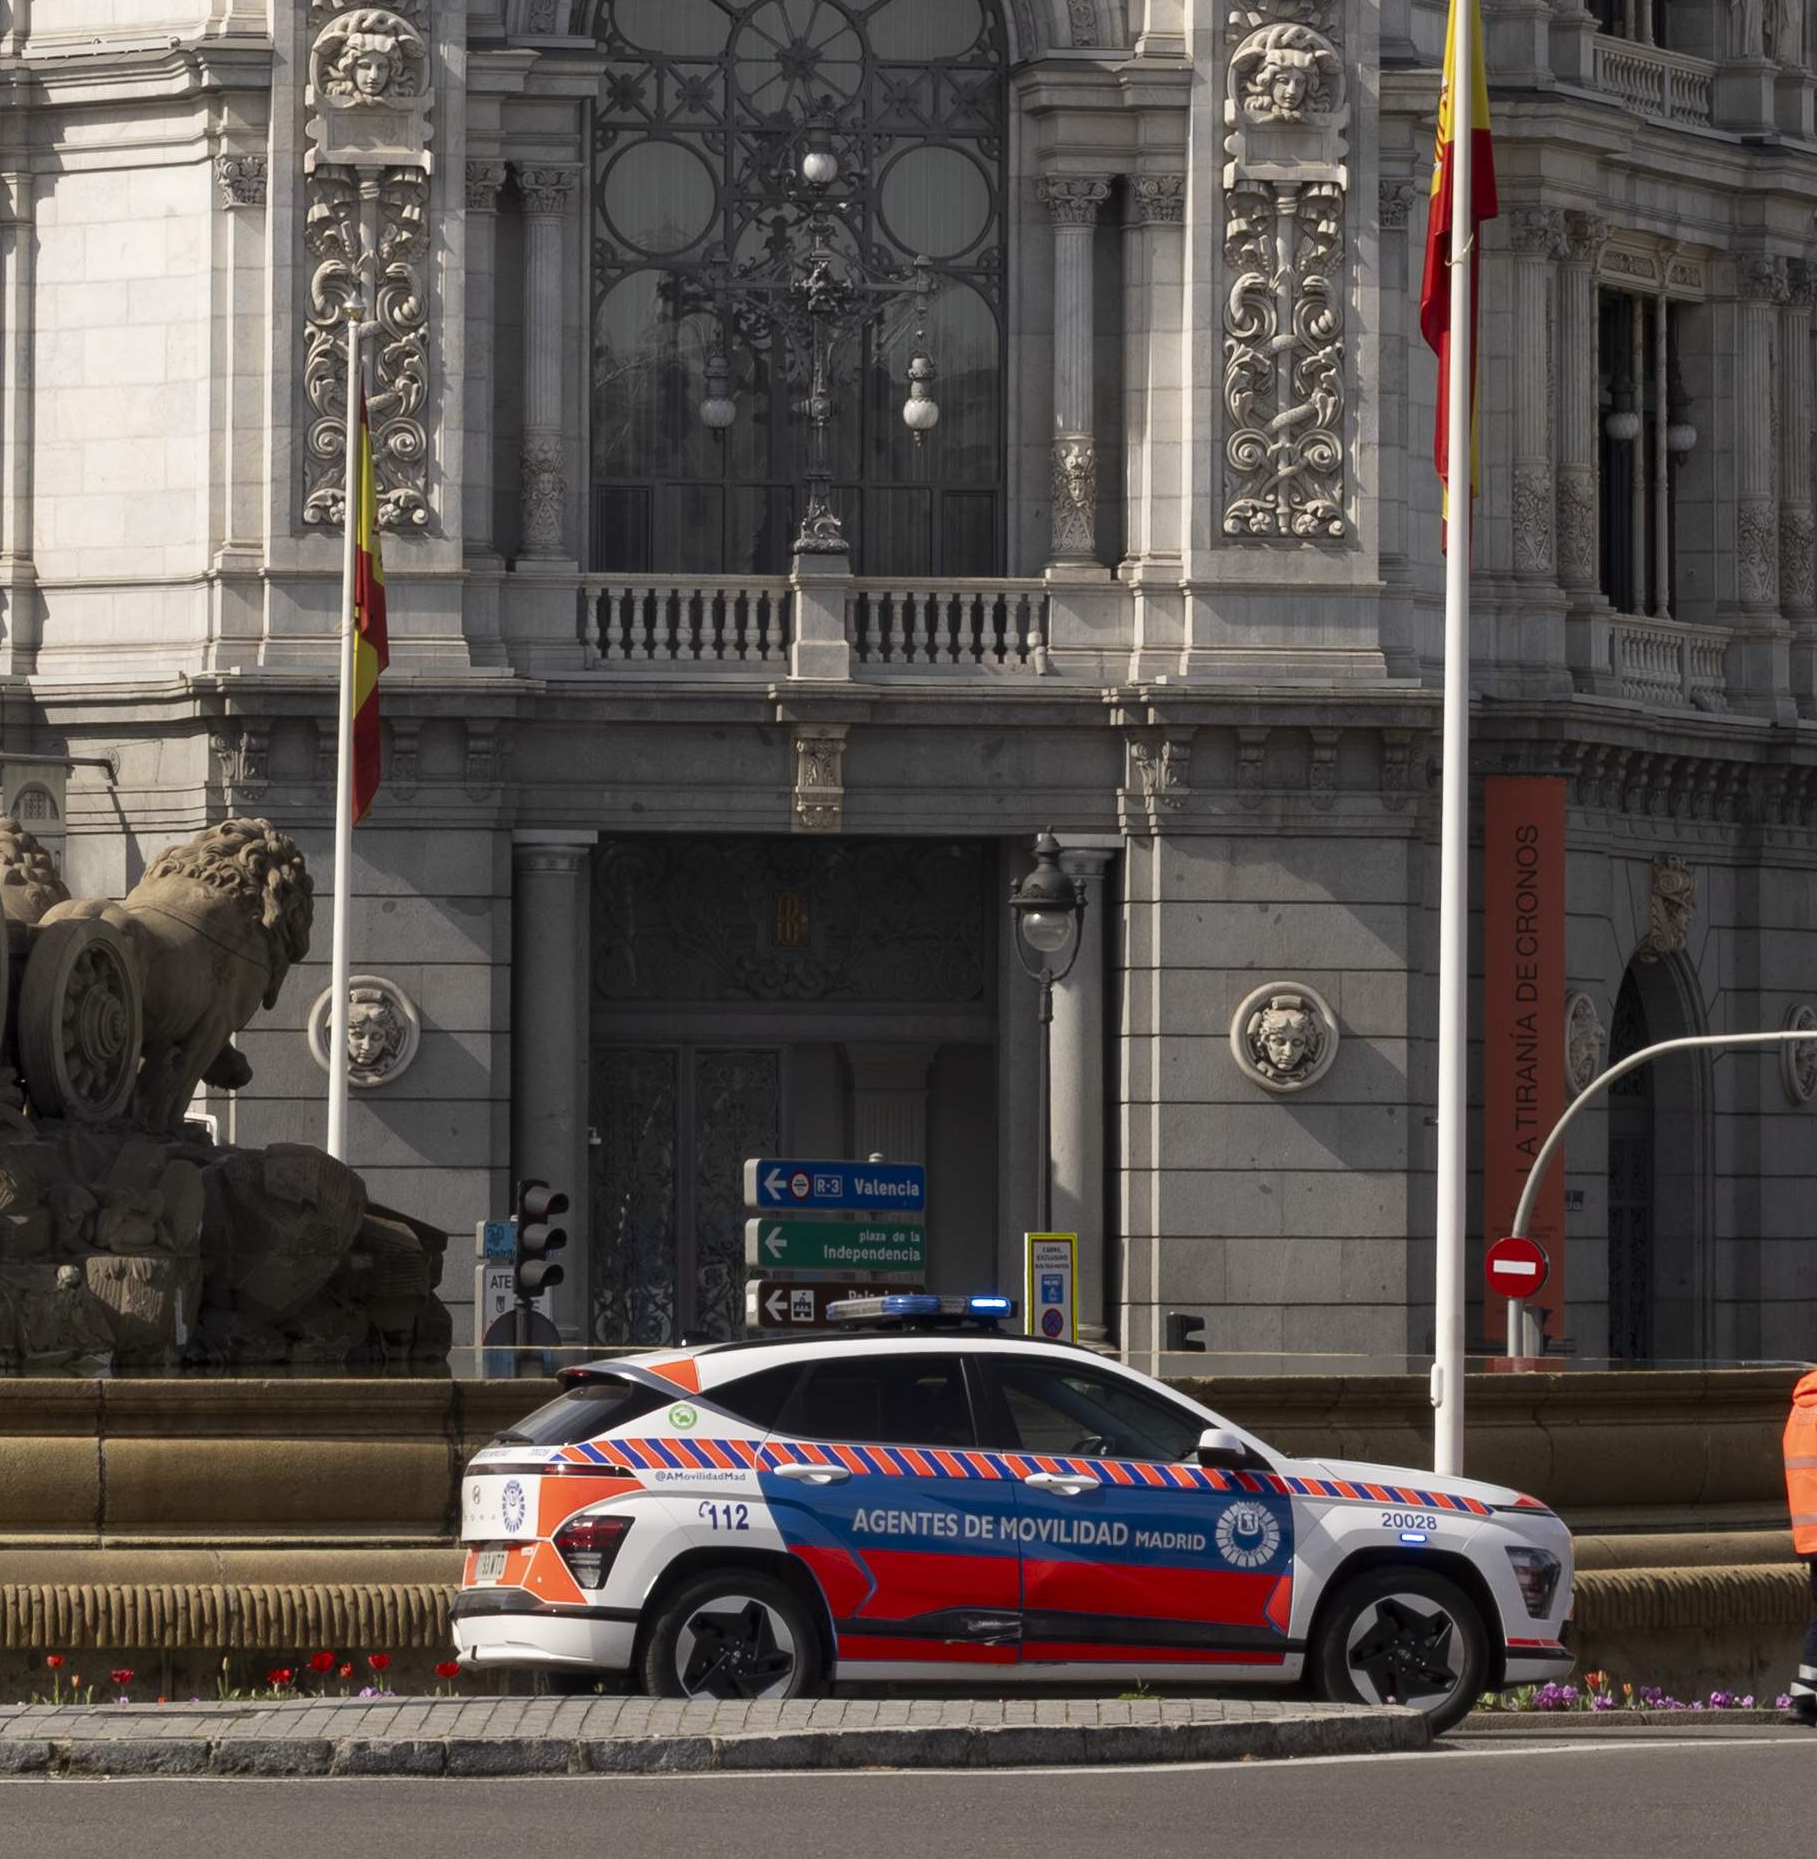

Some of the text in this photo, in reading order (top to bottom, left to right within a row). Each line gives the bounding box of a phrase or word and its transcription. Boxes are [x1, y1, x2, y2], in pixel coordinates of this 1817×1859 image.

[1515, 824, 1539, 957] CRONOS
[1515, 964, 1538, 1002] DE
[1510, 1013, 1538, 1130] TIRANÍA
[817, 1178, 840, 1193] R-3
[854, 1178, 920, 1197] Valencia
[859, 1230, 920, 1244] plaza de la
[823, 1244, 921, 1263] Independencia
[655, 1470, 746, 1482] @AMovilidadMad
[708, 1504, 749, 1530] 112
[1382, 1512, 1438, 1531] 20028
[852, 1508, 1206, 1551] AGENTES DE MOVILIDAD MADRID
